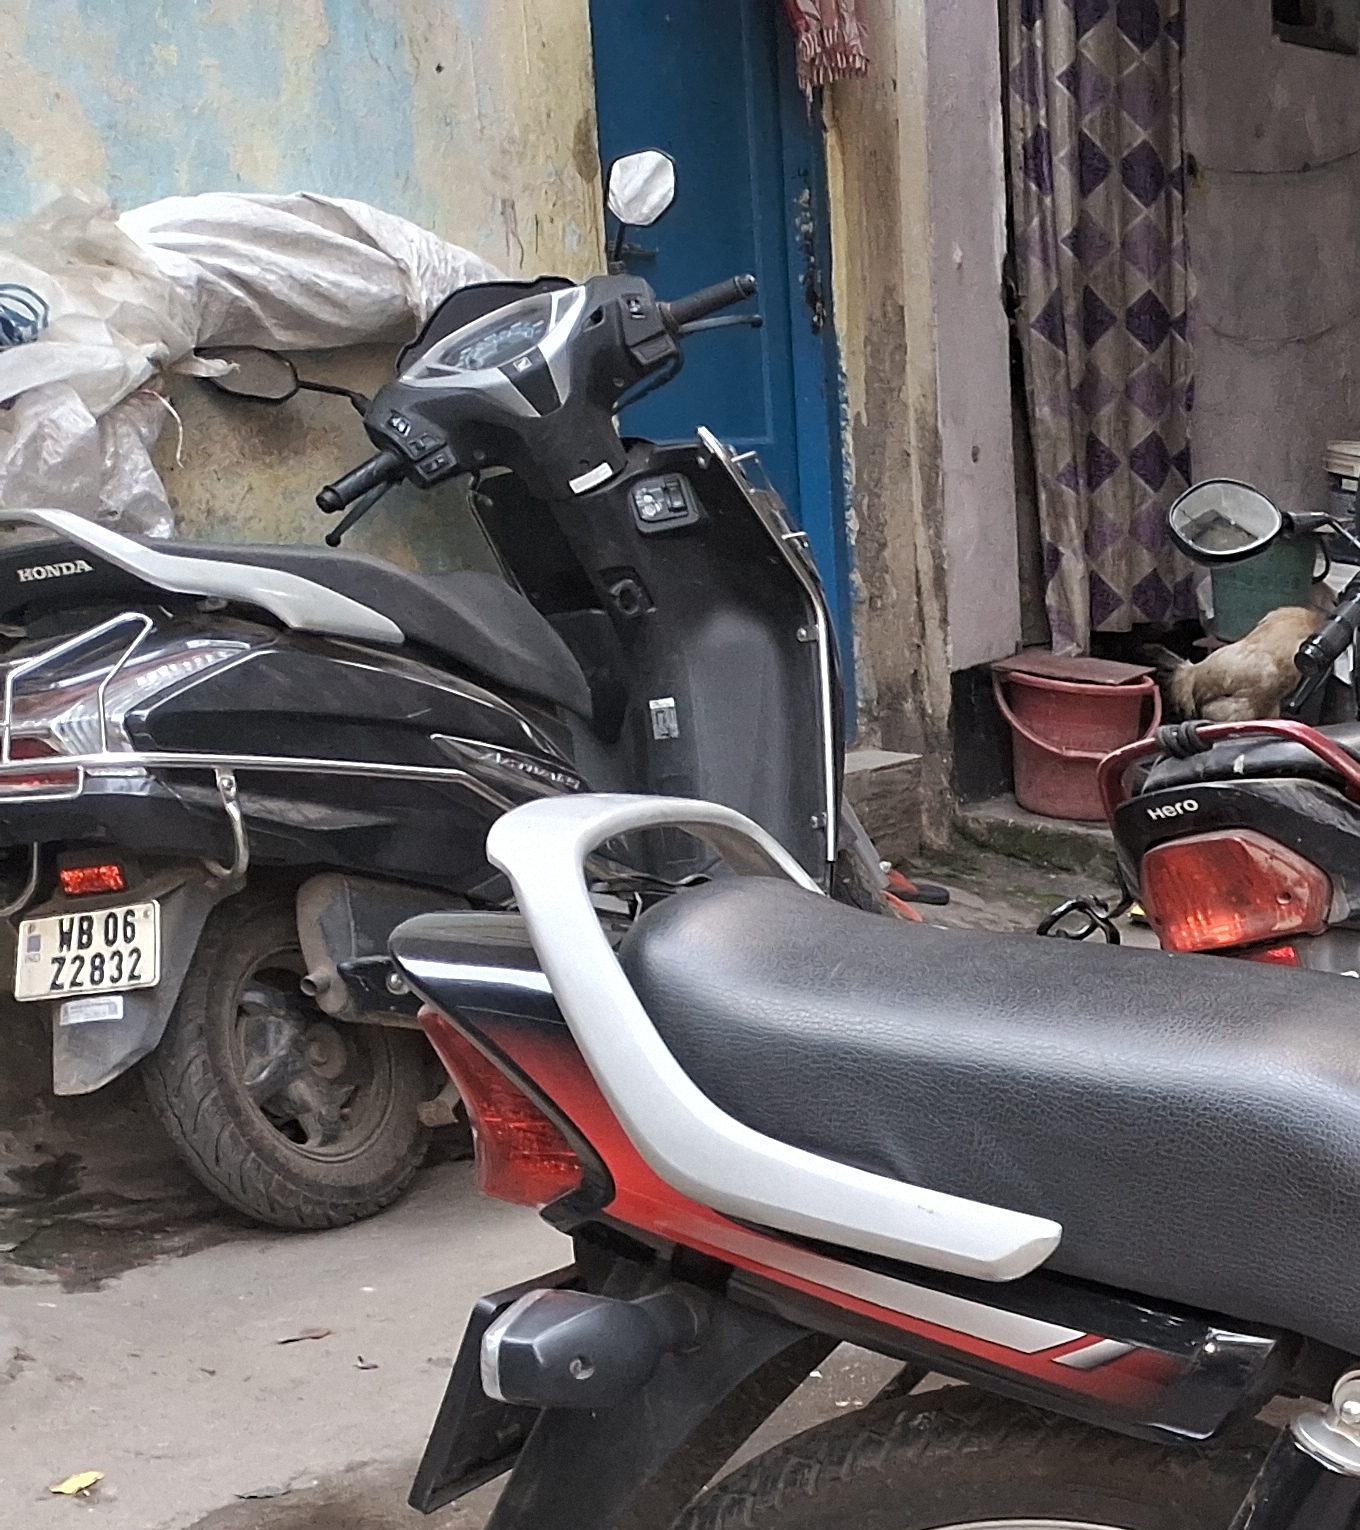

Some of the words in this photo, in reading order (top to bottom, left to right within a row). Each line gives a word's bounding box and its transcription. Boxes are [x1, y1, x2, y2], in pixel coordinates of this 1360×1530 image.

[17, 560, 93, 582] HONDA
[1146, 799, 1199, 820] Hero
[58, 915, 94, 952] WB
[104, 909, 136, 947] 06
[50, 947, 142, 990] Z2832
